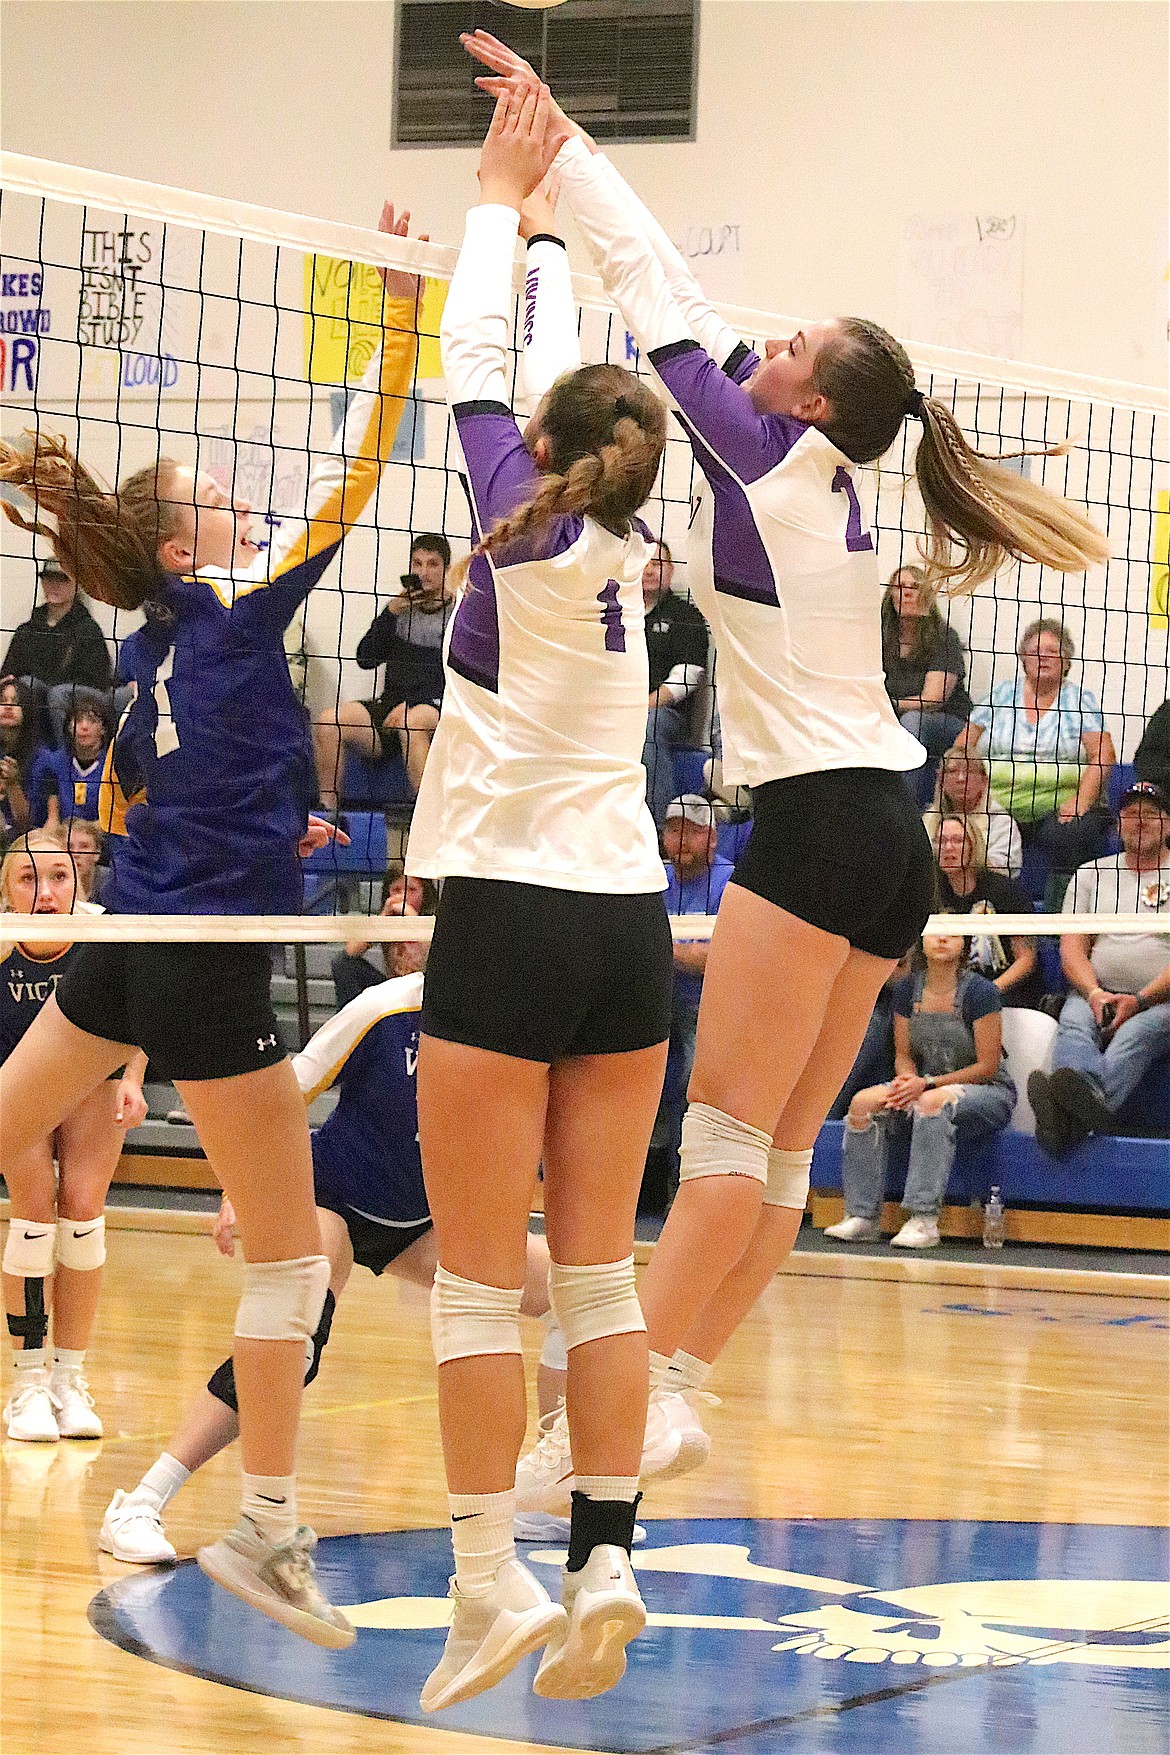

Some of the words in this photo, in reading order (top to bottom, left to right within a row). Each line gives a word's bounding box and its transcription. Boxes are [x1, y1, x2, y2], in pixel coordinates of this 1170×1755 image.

[83, 230, 152, 264] THIS
[79, 289, 146, 320] BIBLE
[79, 319, 144, 345] STUDY
[123, 352, 179, 388] LOUD
[596, 578, 627, 653] 1
